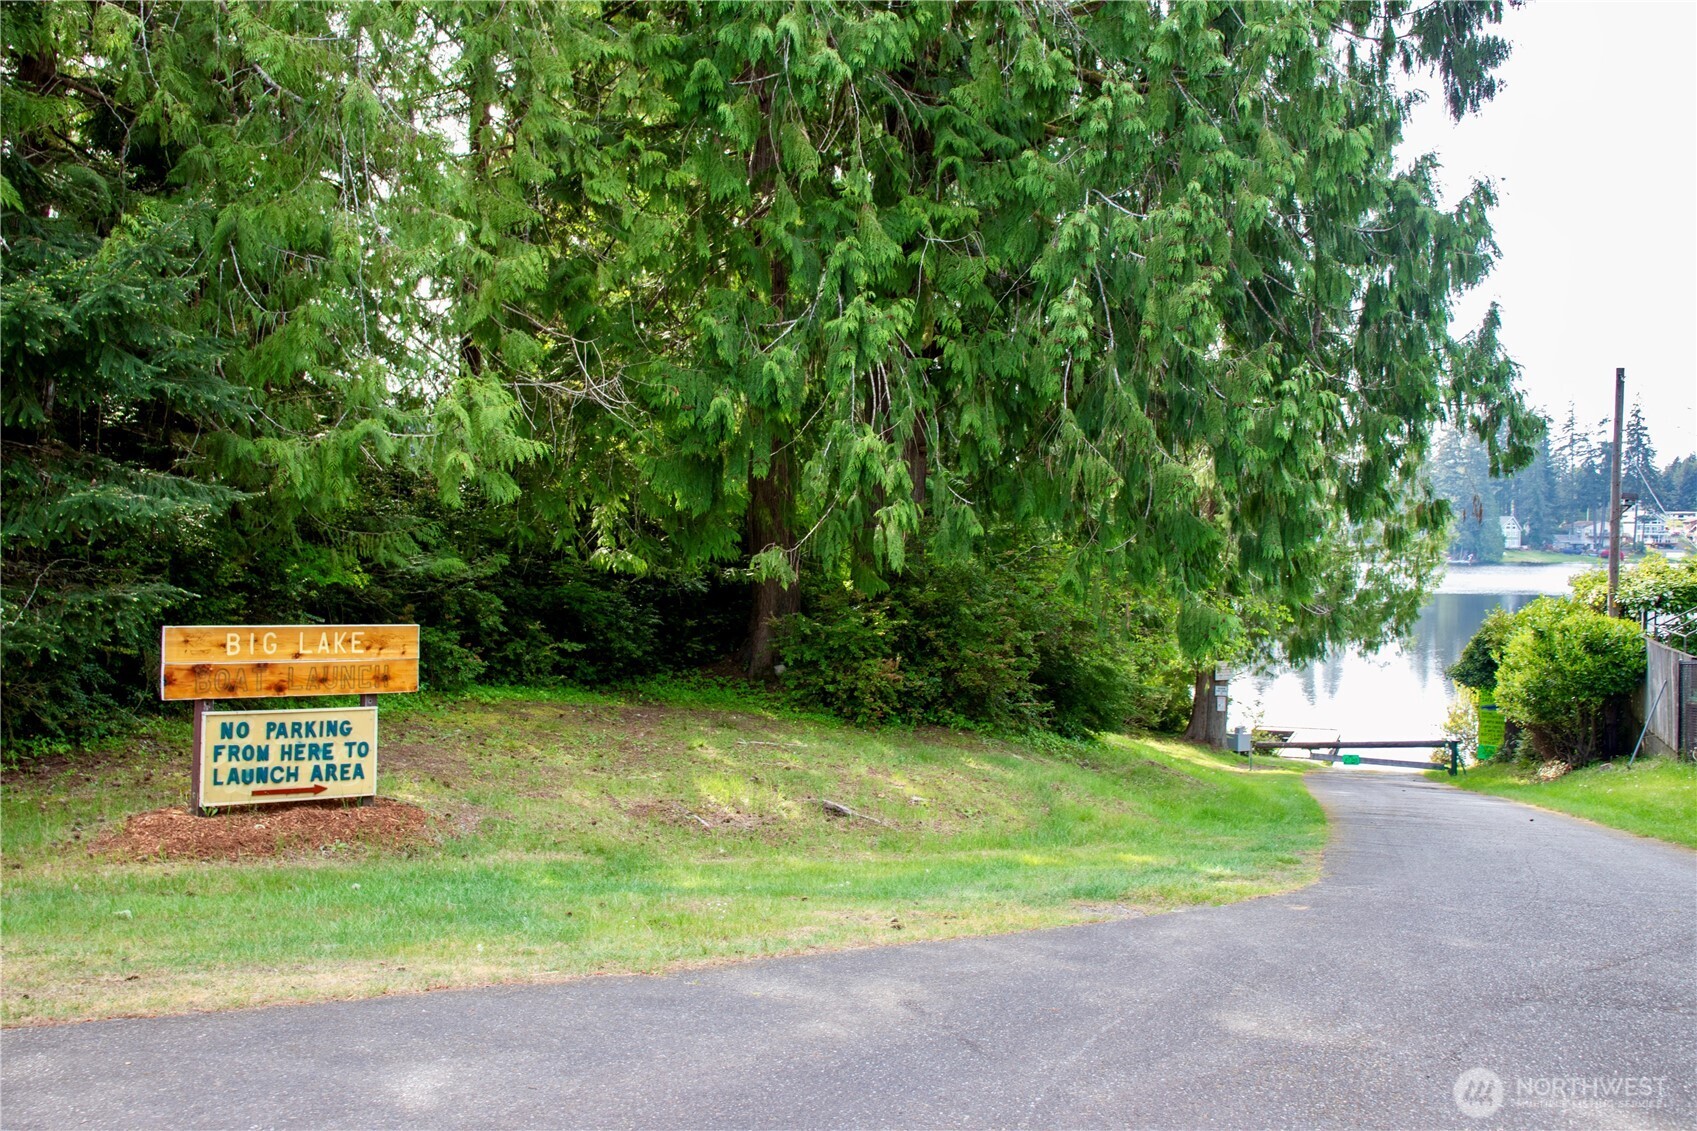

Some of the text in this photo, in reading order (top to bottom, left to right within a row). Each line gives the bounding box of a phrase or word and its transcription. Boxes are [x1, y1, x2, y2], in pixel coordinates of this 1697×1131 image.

[226, 631, 365, 656] BIG LAKE
[194, 665, 389, 694] BOAT LAUNCH
[220, 720, 353, 740] NO PARKING
[213, 741, 370, 763] FROM HERE TO
[213, 763, 365, 786] LAUNCH AREA
